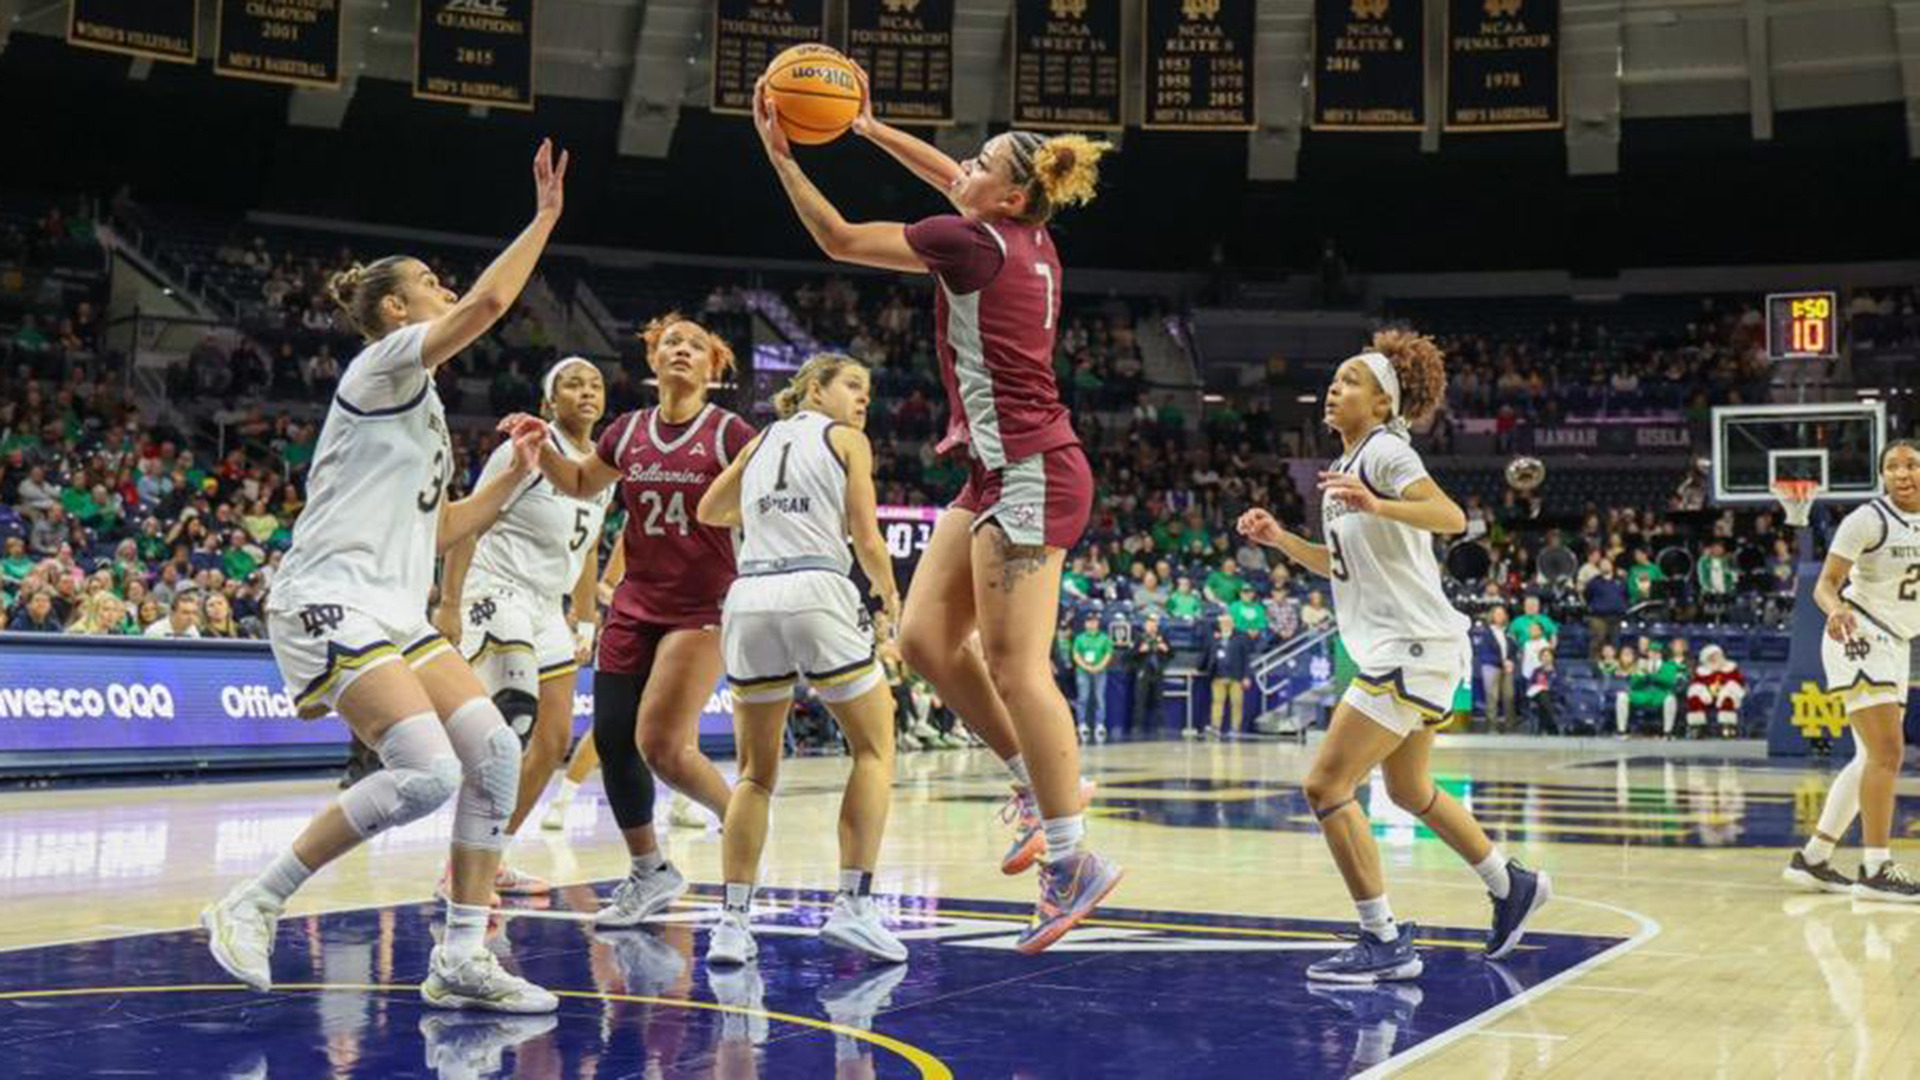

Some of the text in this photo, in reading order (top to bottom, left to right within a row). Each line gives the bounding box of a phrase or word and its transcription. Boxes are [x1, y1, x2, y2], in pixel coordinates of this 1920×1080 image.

[436, 11, 522, 33] CHAMPIONS
[750, 10, 792, 23] NCAA
[880, 17, 923, 30] NCAA
[261, 22, 298, 40] 2001
[721, 18, 819, 39] TOURNAMENT
[851, 29, 949, 45] TOURNAMENT
[1047, 22, 1091, 36] NCAA
[1178, 24, 1223, 36] NCAA
[1346, 24, 1392, 36] NCAA
[1480, 22, 1526, 35] NCAA
[1032, 36, 1084, 51] SWEET
[1165, 39, 1217, 52] ELITE
[1336, 38, 1387, 51] ELITE
[1454, 34, 1550, 50] FINAL FOUR
[456, 47, 494, 65] 2015
[1326, 56, 1360, 71] 2016
[1484, 72, 1521, 87] 1978
[1034, 262, 1054, 329] 7
[1793, 319, 1824, 351] 10
[1636, 428, 1690, 446] GISELA
[626, 462, 705, 484] Bellarmine
[774, 441, 792, 491] 1
[640, 490, 690, 536] 24
[569, 507, 590, 551] 5
[107, 684, 174, 719] QQQ
[222, 685, 300, 718] Offici
